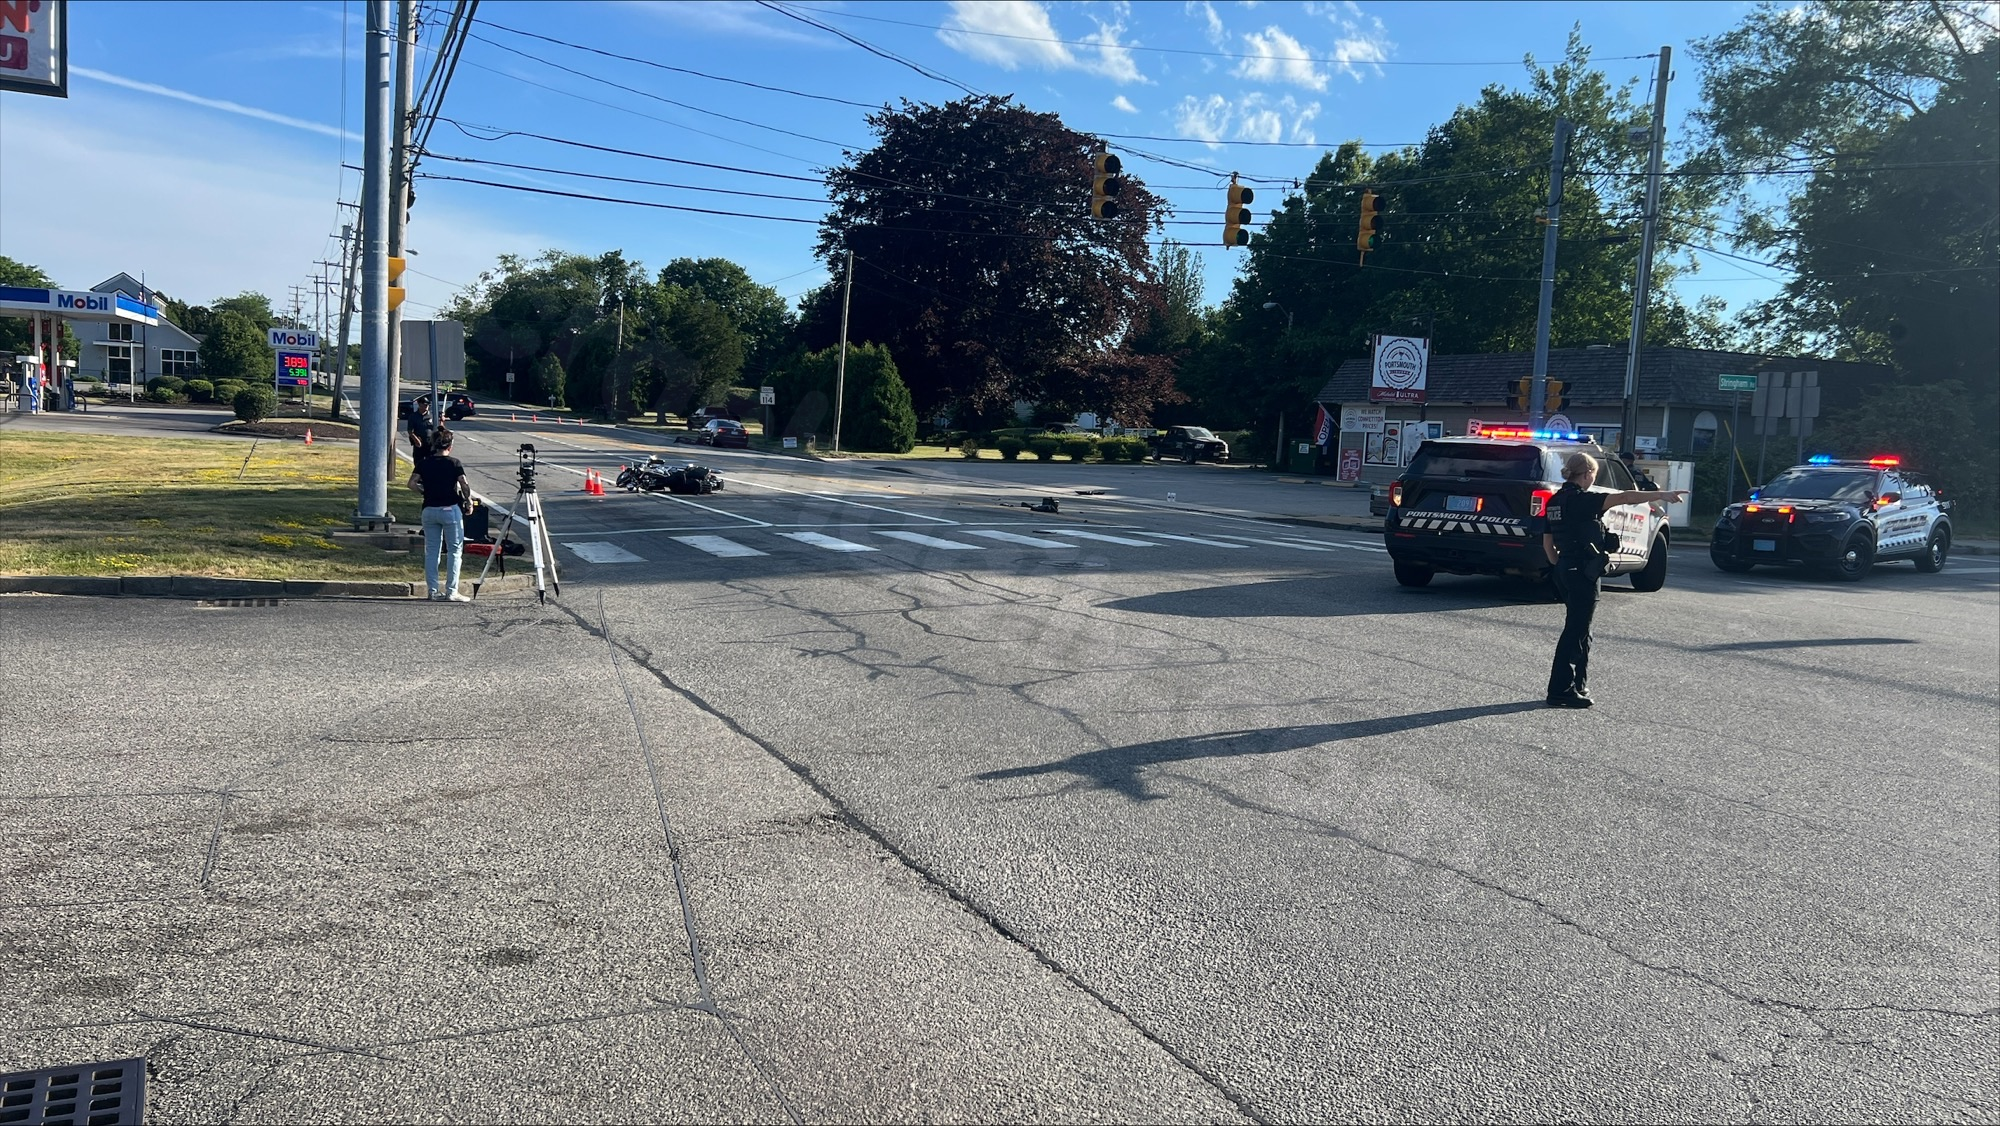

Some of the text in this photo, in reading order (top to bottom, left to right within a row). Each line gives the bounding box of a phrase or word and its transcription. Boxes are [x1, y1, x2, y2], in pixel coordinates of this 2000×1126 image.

[57, 294, 108, 310] Mobil
[273, 332, 315, 346] Mobil
[1384, 361, 1416, 370] PORTSMOUTH
[1720, 378, 1748, 389] Stringham
[1406, 510, 1521, 525] PORTSMOUTH POLICE
